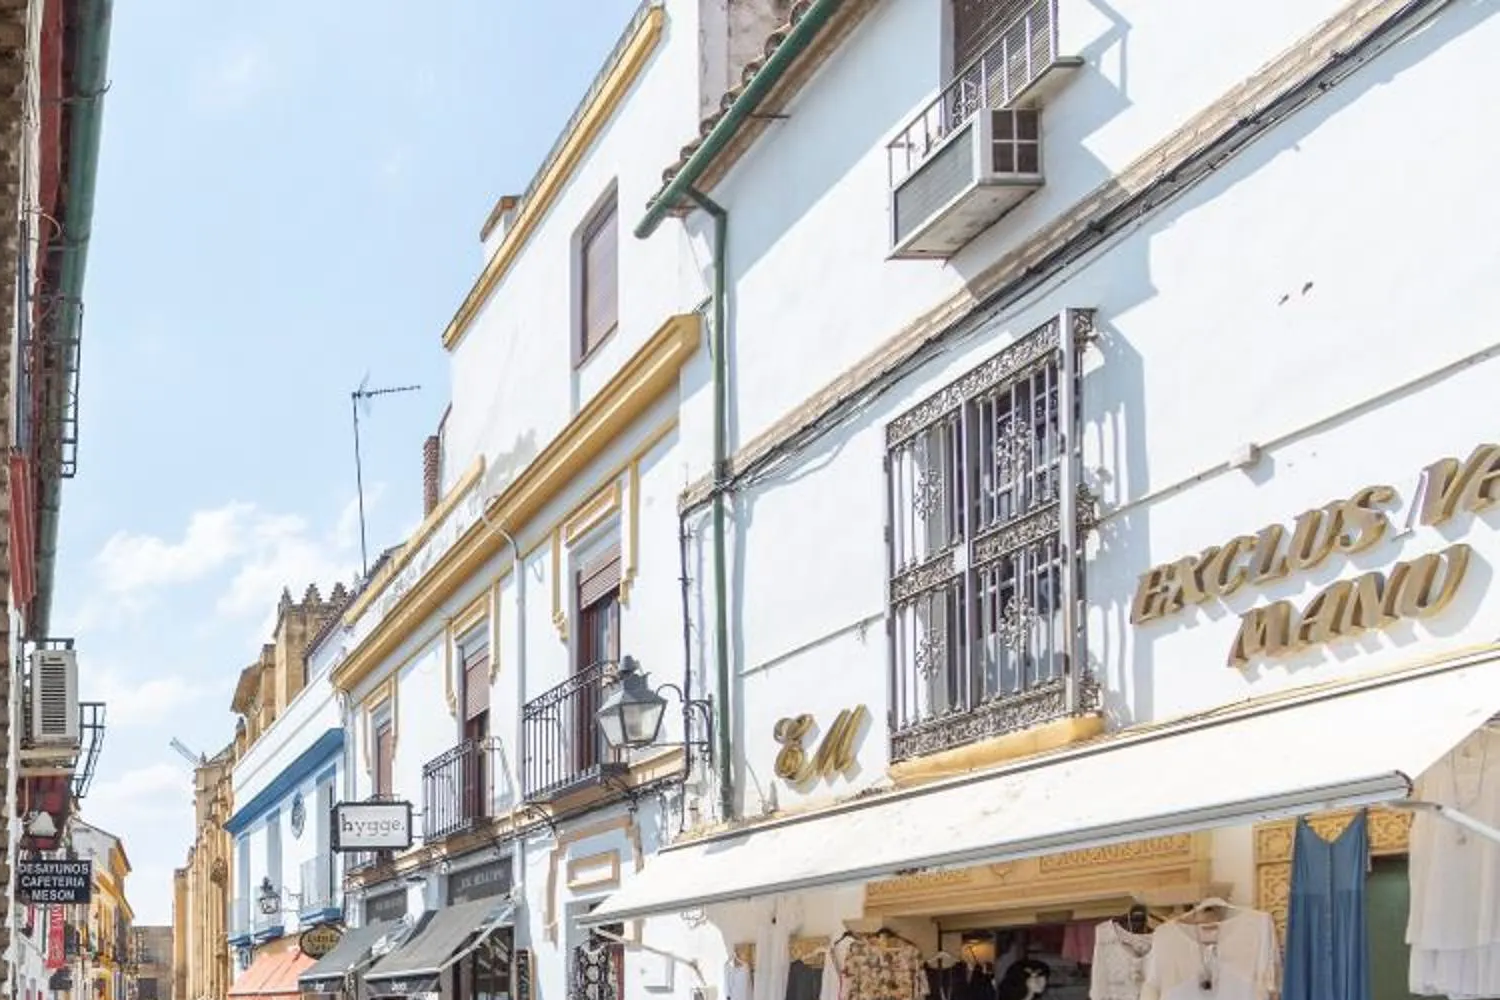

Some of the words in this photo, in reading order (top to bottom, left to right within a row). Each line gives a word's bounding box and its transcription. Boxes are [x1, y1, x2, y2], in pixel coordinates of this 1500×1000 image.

[1227, 543, 1474, 668] MANU
[19, 862, 89, 875] DESAYUNOS
[21, 876, 85, 888] CAFETERIA
[31, 889, 76, 901] MESON
